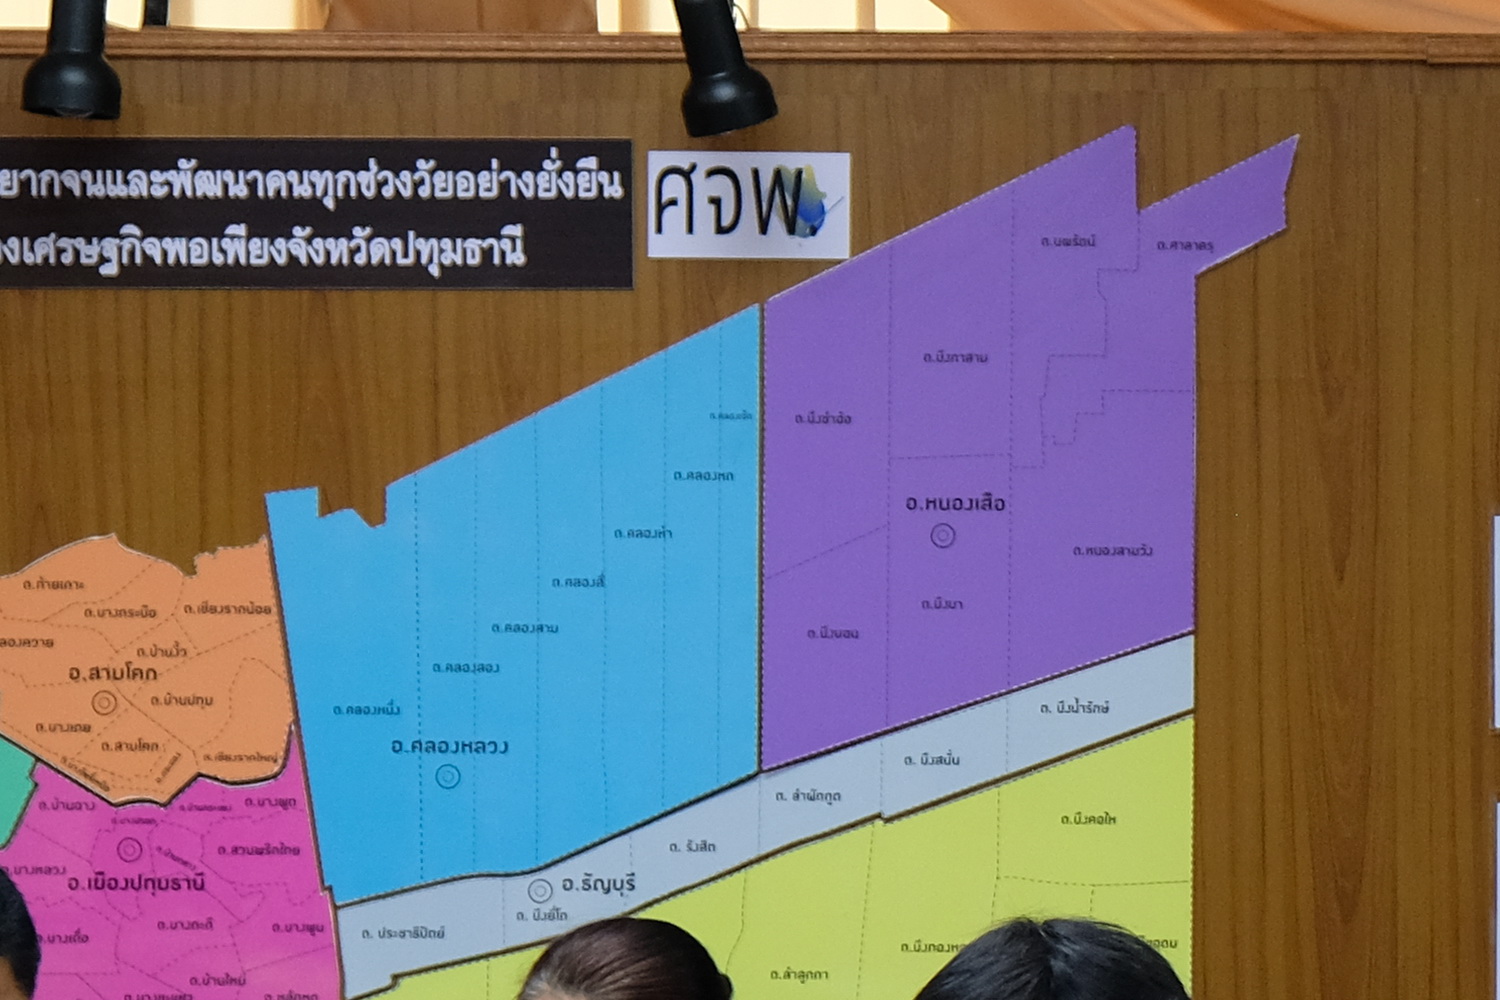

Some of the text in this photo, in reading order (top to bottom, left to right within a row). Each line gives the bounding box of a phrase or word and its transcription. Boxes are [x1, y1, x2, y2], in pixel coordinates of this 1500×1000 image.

[0, 223, 528, 279] งเศรษฐกิจพอเพียงจังหวัดปทุมธานี
[906, 492, 1005, 511] อ.หนองเสือ
[69, 661, 157, 683] อ.สามโคก
[392, 739, 508, 754] อ.คลองหลวง
[68, 870, 206, 896] อ.เมืองปทุมธานี
[562, 872, 635, 897] อ.ธัญบุรี
[900, 937, 968, 952] ต.บึงทองห
